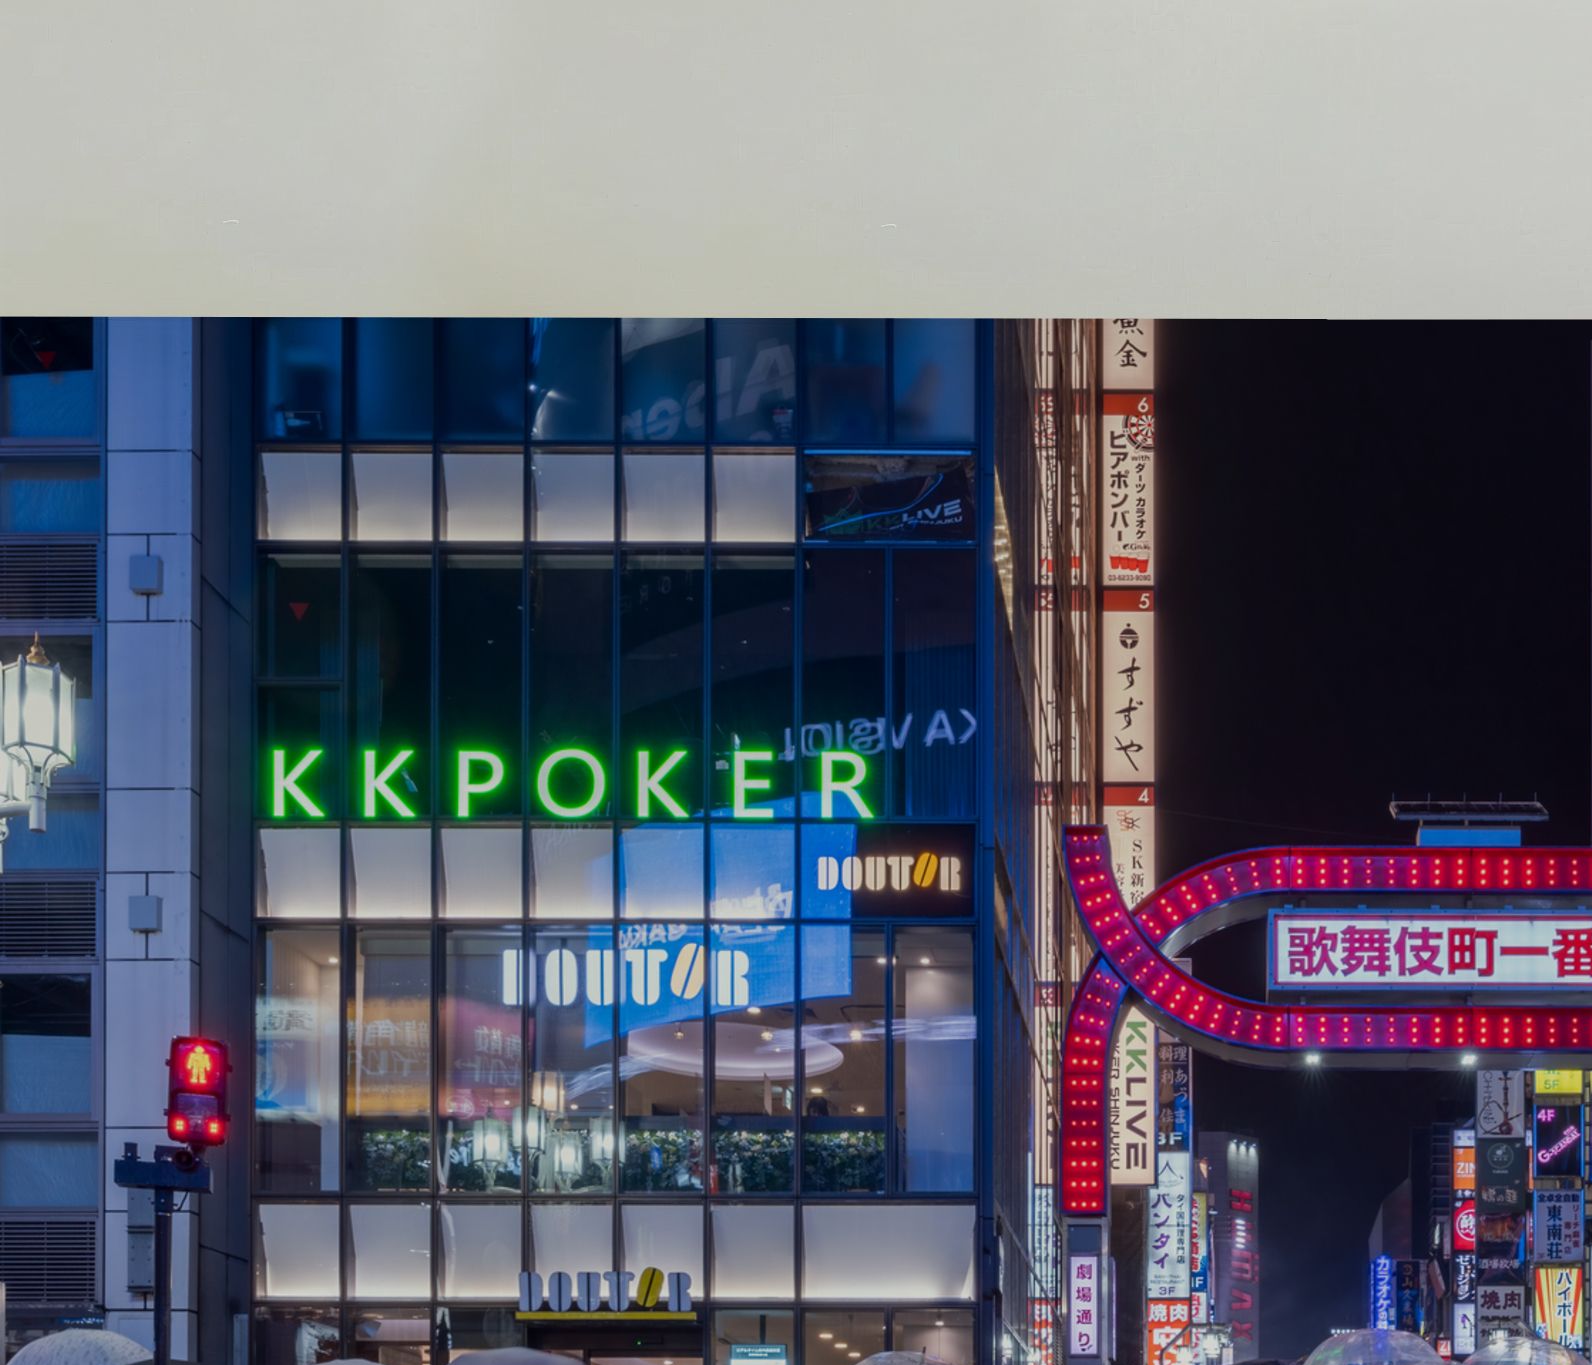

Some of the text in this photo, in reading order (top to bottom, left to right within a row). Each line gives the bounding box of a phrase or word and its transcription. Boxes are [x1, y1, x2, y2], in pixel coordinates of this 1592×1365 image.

[1137, 398, 1149, 412] 6
[1110, 430, 1130, 541] ビアポンバー
[1138, 593, 1150, 608] 5
[271, 748, 874, 818] KKPOKER
[1138, 788, 1149, 803] 4
[817, 852, 961, 891] DOUTOR
[502, 943, 749, 1006] DOUTOR
[1126, 1021, 1148, 1170] KKLIVE
[1537, 1108, 1556, 1123] 4F
[1152, 1193, 1173, 1270] バンタイ
[518, 1266, 692, 1312] DOUTOR
[1075, 1263, 1095, 1352] 劇場通り
[1148, 1303, 1188, 1322] 焼肉
